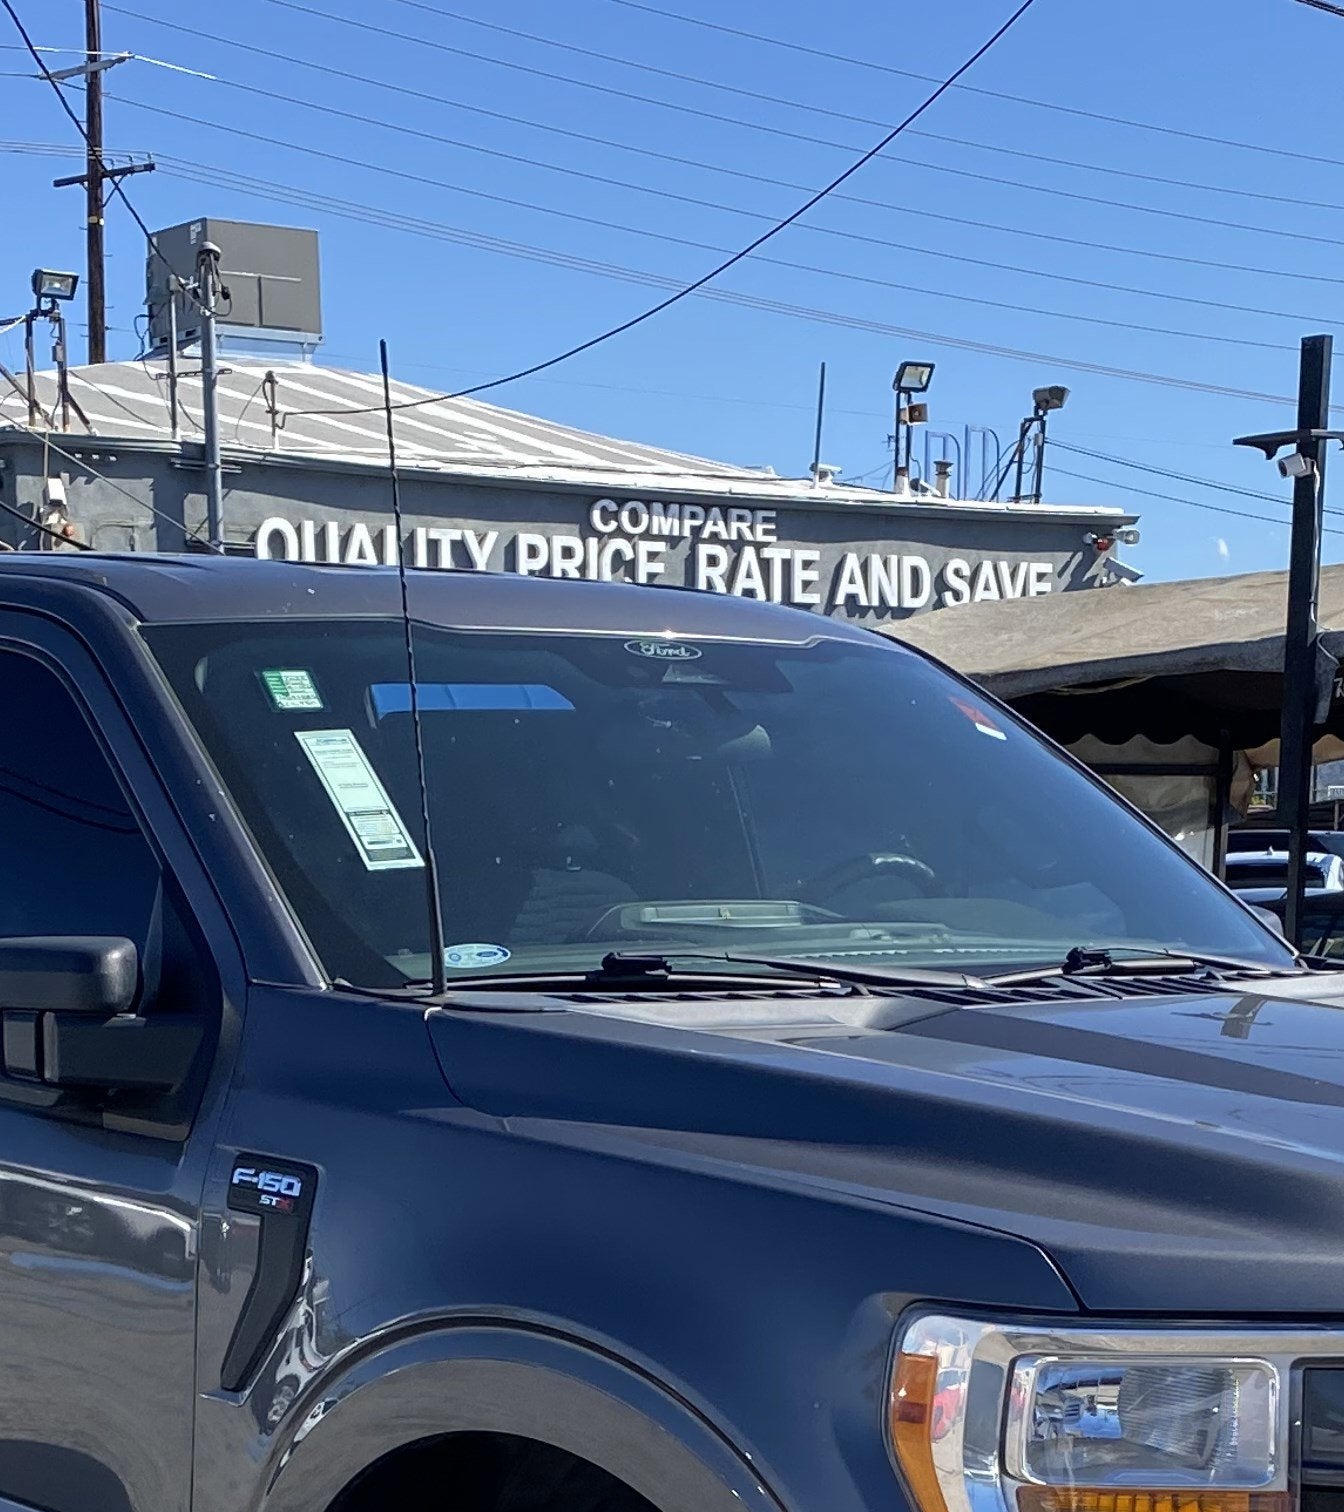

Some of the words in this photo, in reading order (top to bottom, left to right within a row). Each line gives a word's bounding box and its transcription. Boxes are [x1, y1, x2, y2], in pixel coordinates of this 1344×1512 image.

[589, 499, 777, 542] COMPARE
[256, 517, 499, 571] QUALITY
[515, 533, 667, 584] PRICE
[694, 543, 821, 604] RATE
[834, 552, 931, 608] AND
[942, 558, 1053, 607] SAVE
[232, 1167, 302, 1197] F-150
